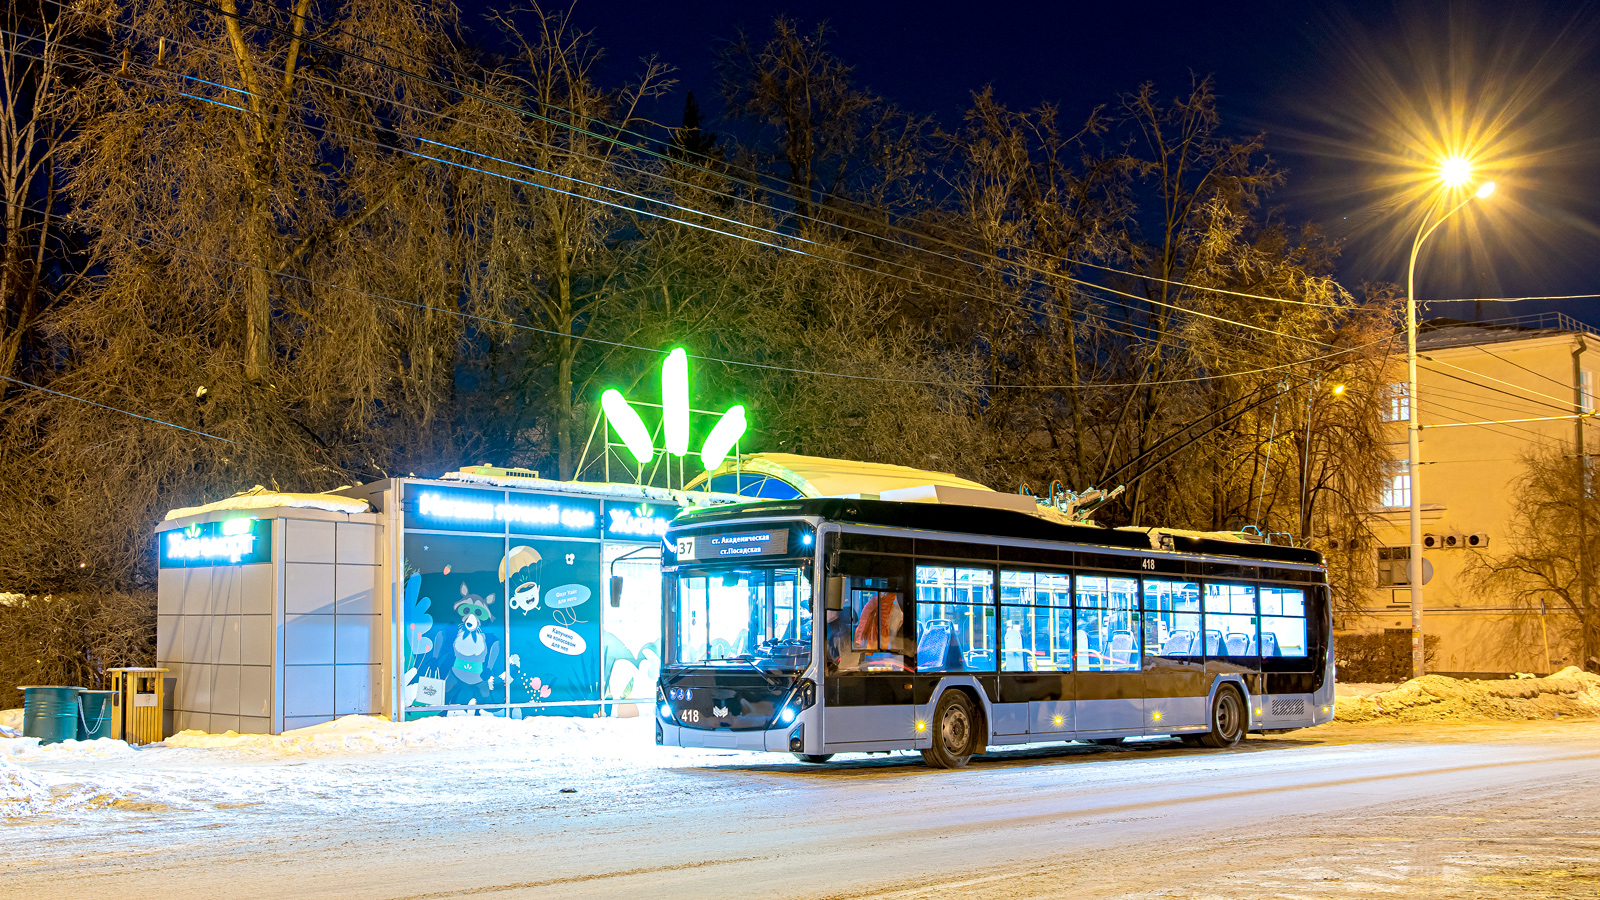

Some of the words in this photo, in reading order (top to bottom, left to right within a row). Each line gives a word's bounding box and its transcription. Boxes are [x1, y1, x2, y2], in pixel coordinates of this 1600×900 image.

[721, 534, 770, 544] Академическая
[679, 542, 693, 554] 37
[1142, 558, 1155, 570] 418
[552, 628, 573, 640] Капучино
[681, 709, 699, 722] 418
